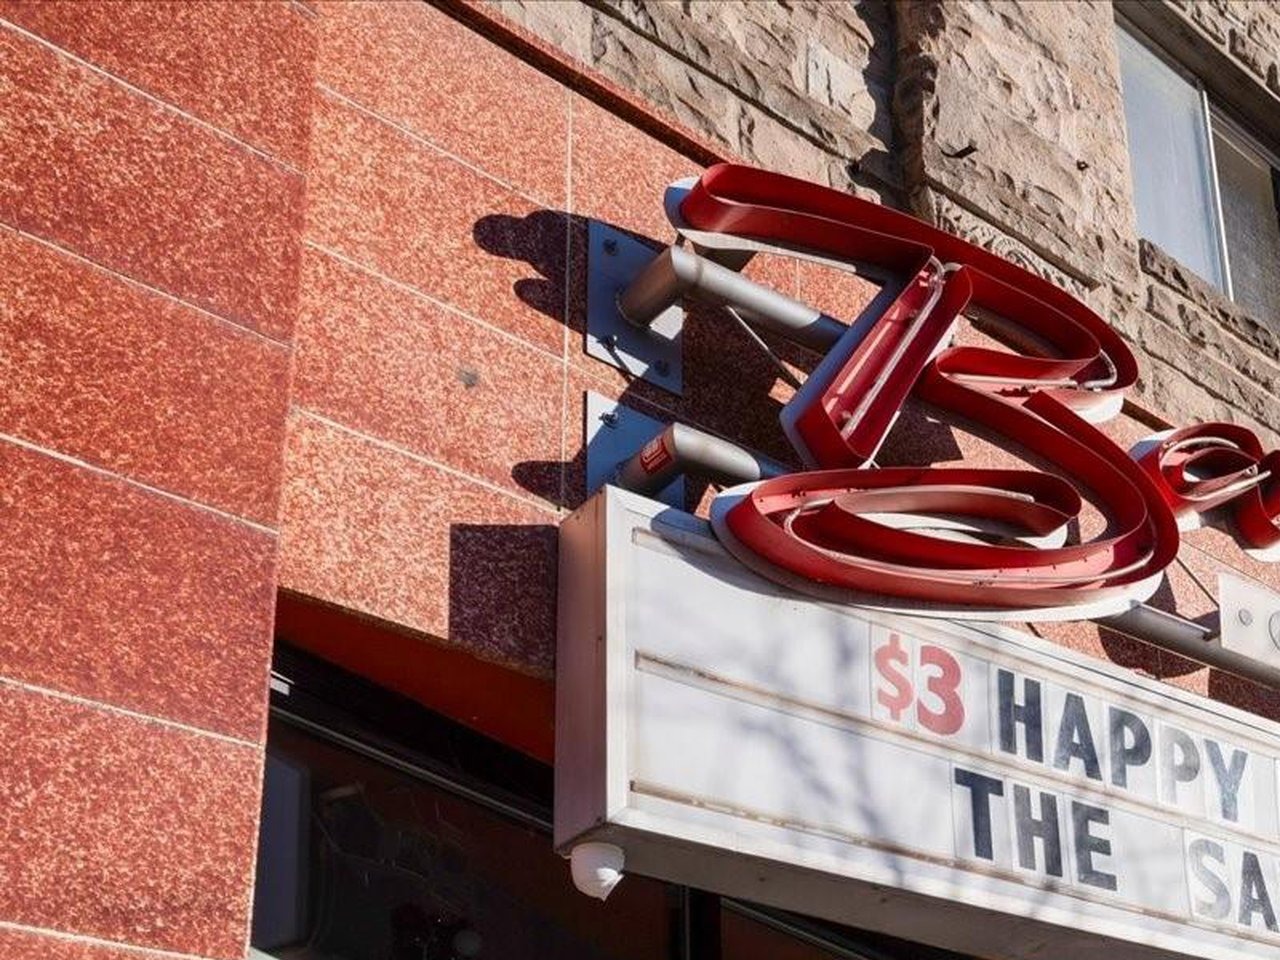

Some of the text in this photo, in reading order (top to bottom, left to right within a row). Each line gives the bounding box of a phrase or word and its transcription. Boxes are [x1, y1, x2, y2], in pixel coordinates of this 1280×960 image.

[874, 634, 965, 736] $3
[998, 669, 1247, 822] HAPPY
[955, 768, 1117, 891] THE
